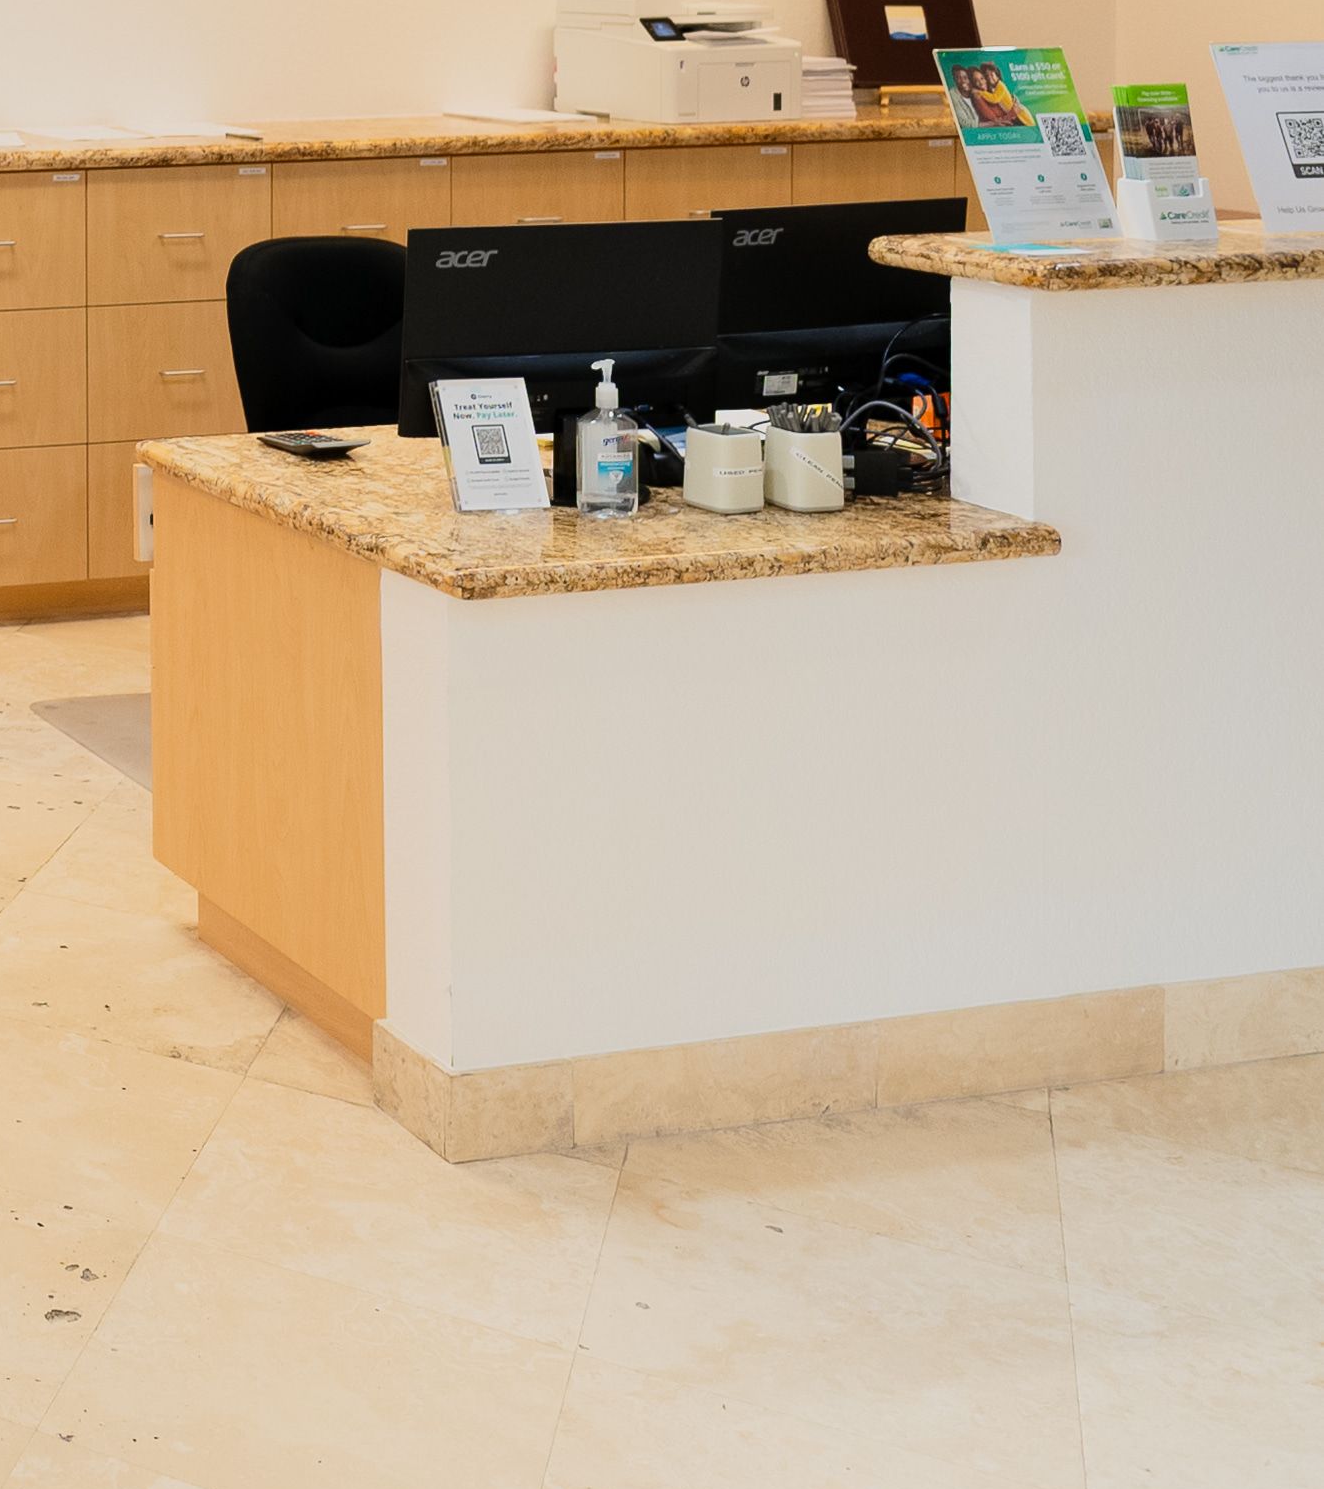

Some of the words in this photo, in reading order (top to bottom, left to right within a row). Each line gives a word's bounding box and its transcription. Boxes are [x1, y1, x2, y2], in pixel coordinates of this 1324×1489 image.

[1299, 165, 1324, 176] SCAN
[732, 228, 784, 247] acer
[436, 249, 499, 269] acer
[454, 403, 477, 411] Treat
[477, 401, 513, 410] Yourself
[477, 412, 491, 421] Pay
[795, 451, 823, 474] CLEAN
